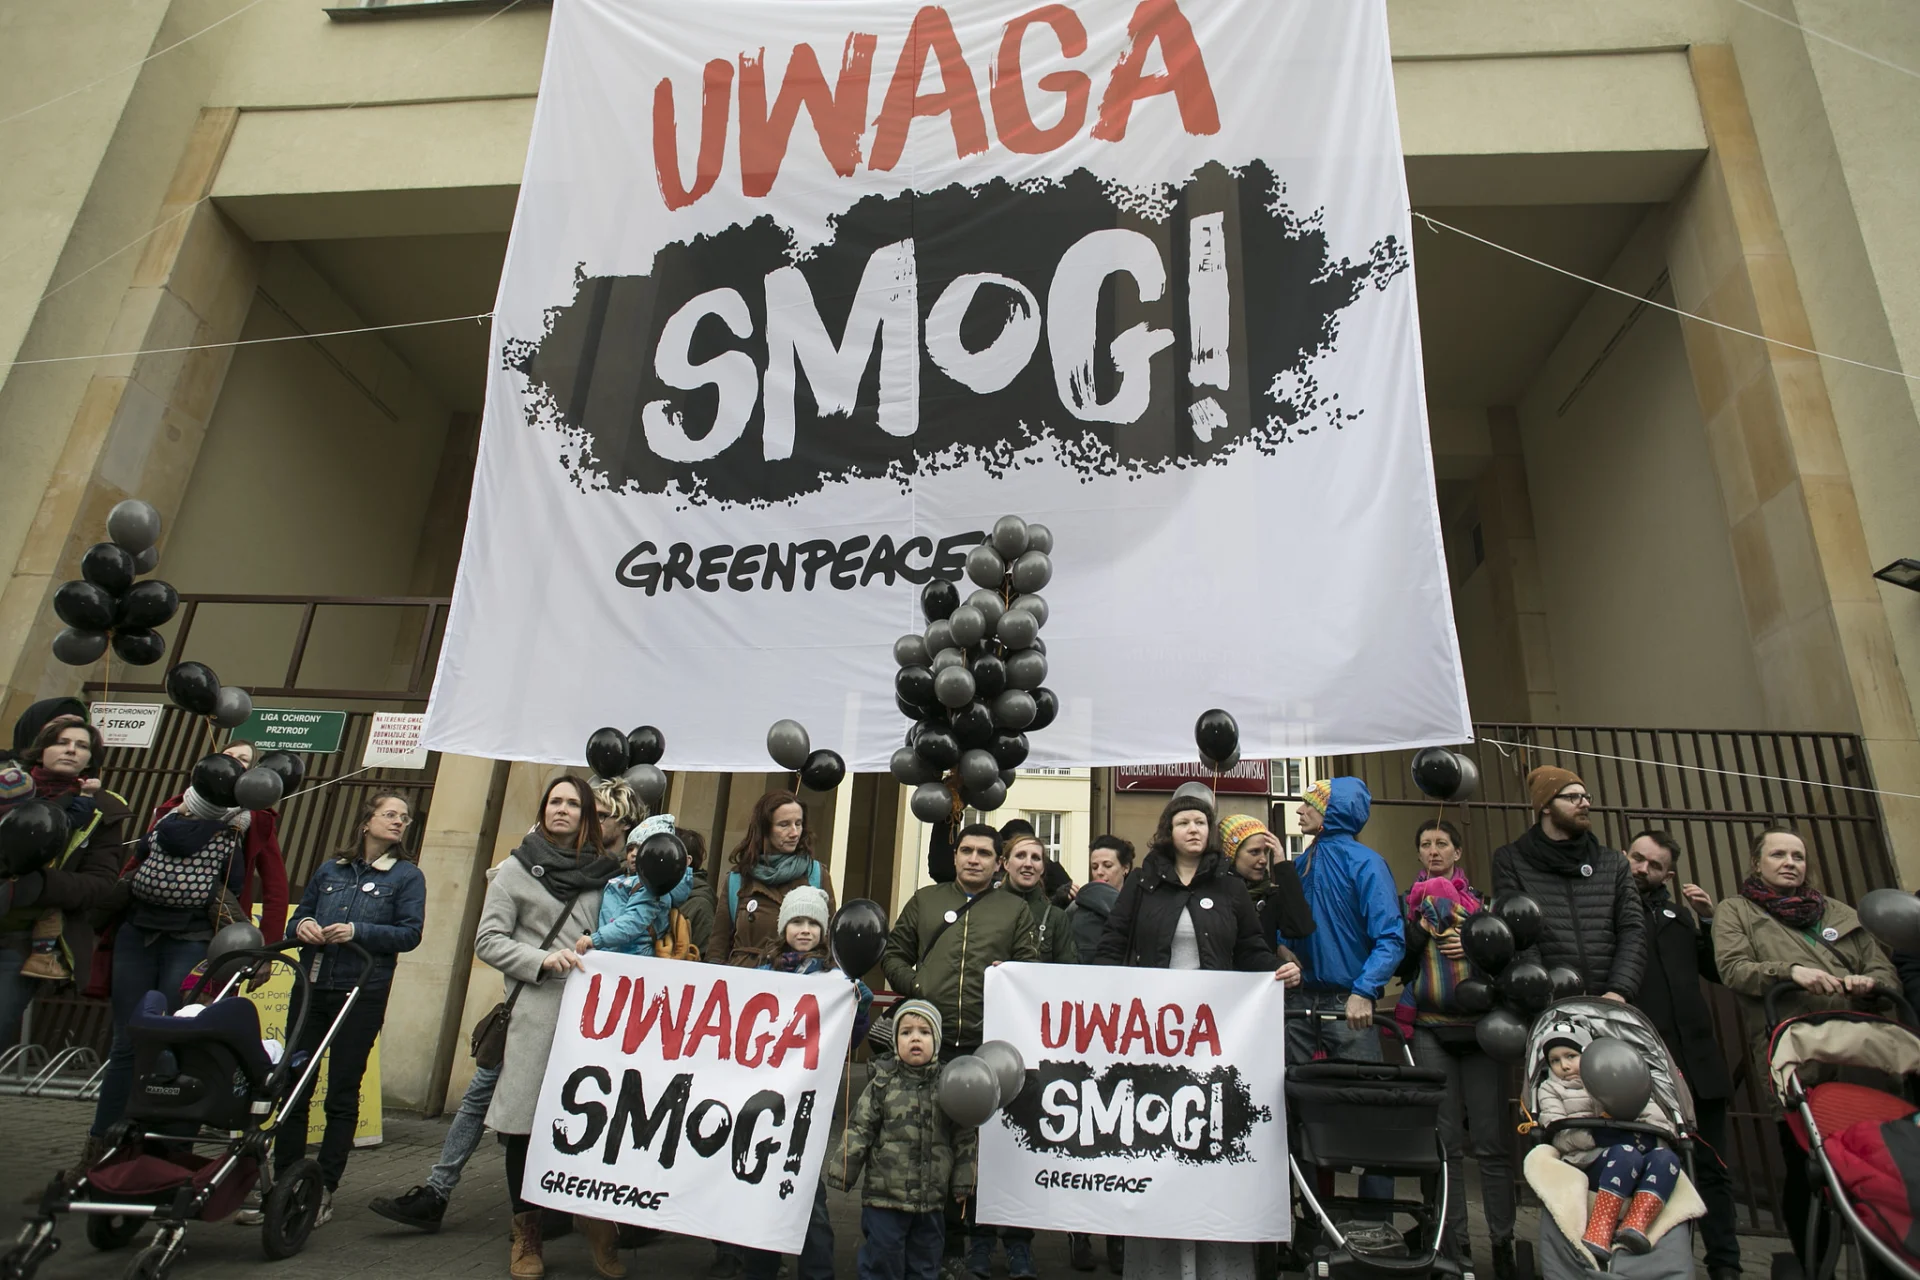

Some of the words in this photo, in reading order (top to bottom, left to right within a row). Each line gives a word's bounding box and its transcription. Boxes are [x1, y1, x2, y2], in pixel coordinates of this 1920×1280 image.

[652, 0, 1221, 211] UWAGA
[615, 530, 986, 597] GREENPEACE
[107, 719, 146, 729] STEKOP
[118, 708, 157, 716] CHRONIONY
[260, 713, 279, 721] LIGA
[282, 714, 322, 723] OCHRONY
[266, 726, 310, 735] PRZYRODY
[254, 740, 276, 749] OKRĘG
[580, 973, 821, 1070] UWAGA
[1040, 998, 1222, 1057] UWAGA
[540, 1170, 669, 1211] GREENPEACE
[1034, 1169, 1153, 1194] GREENPEACE
